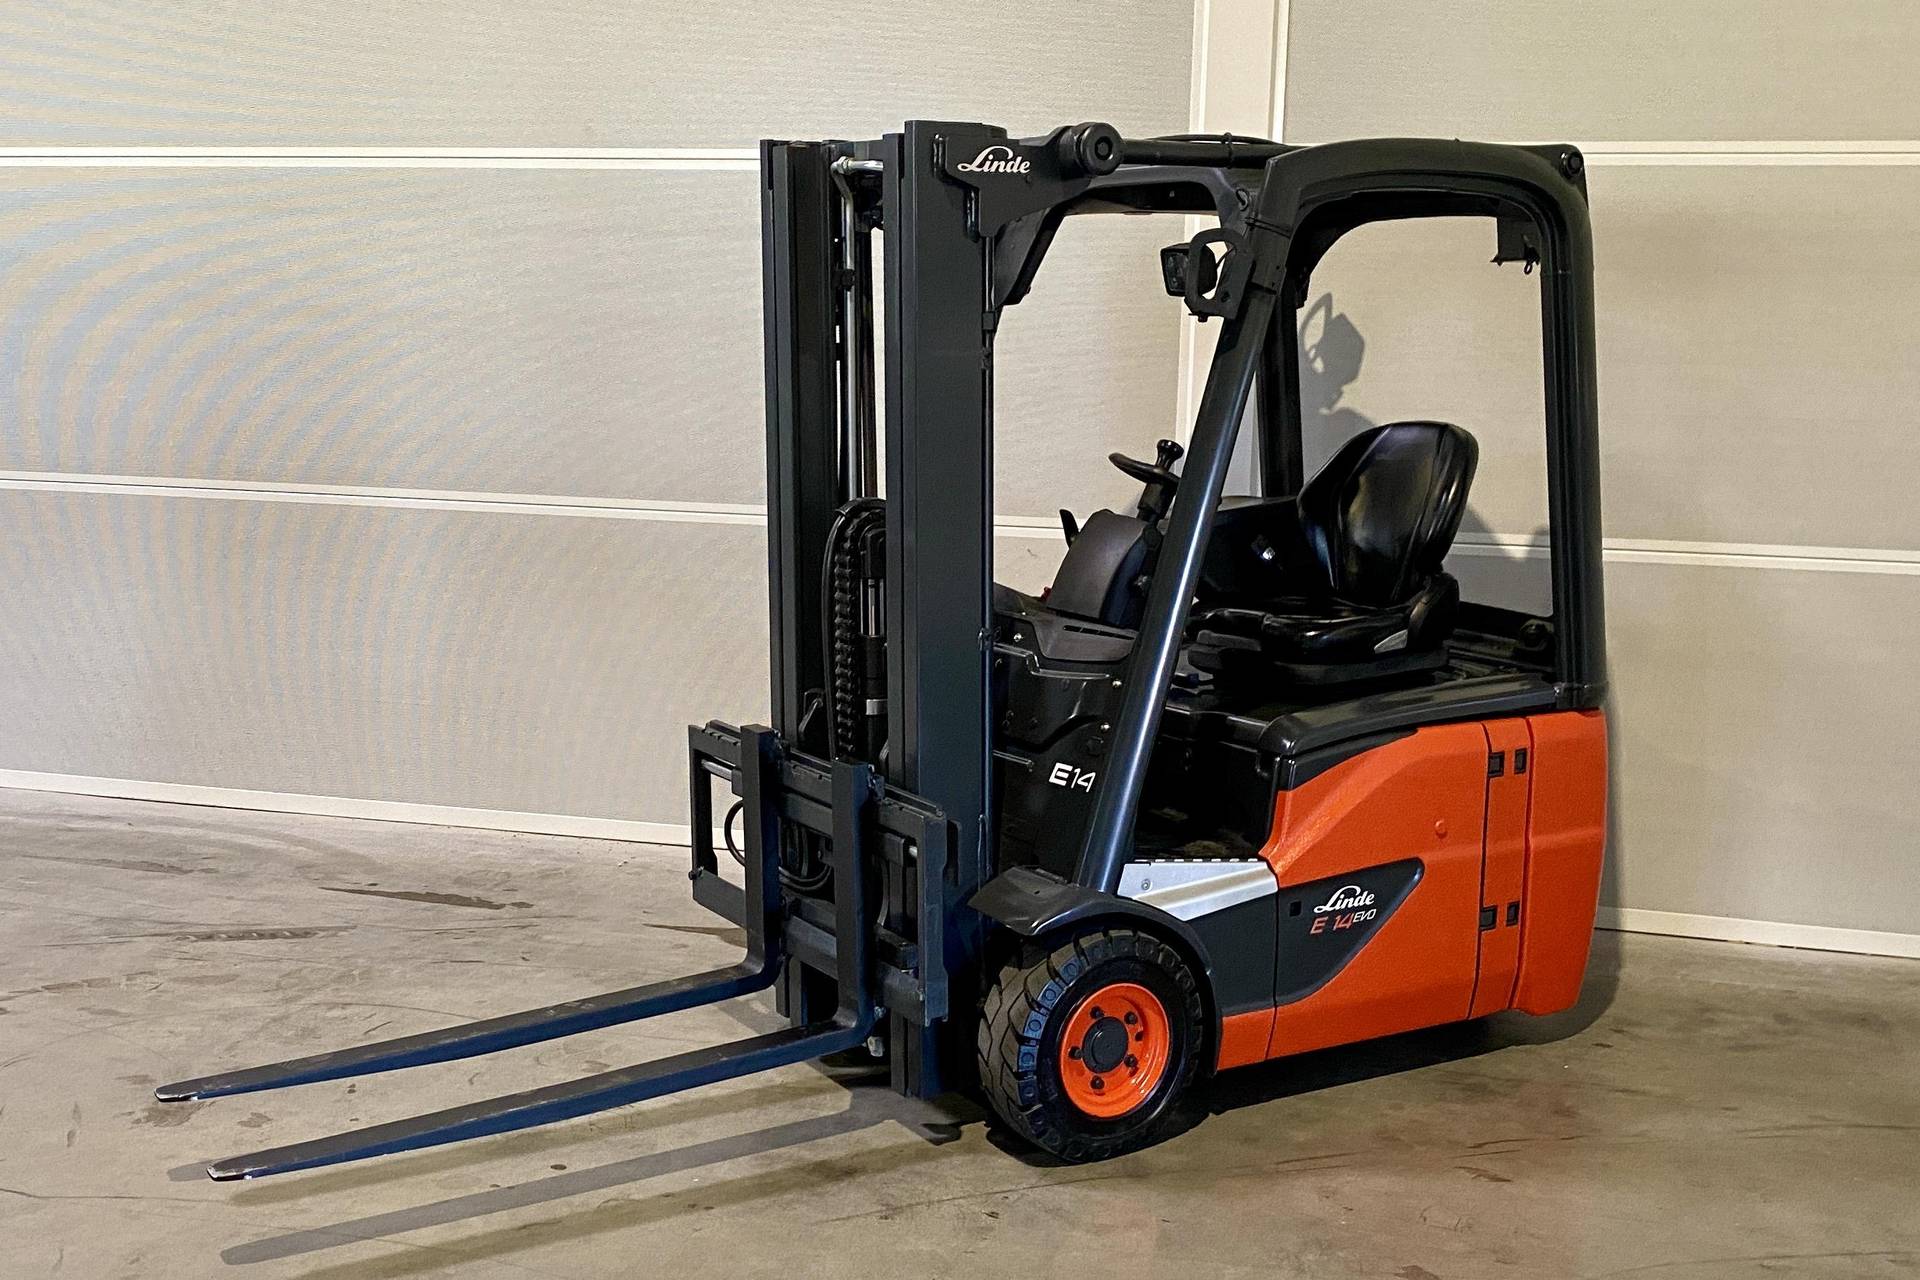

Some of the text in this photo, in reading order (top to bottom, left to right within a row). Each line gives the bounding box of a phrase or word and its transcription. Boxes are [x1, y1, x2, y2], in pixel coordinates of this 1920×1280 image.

[957, 145, 1031, 174] Linde
[1049, 762, 1096, 793] E14
[1313, 885, 1375, 914] Linde
